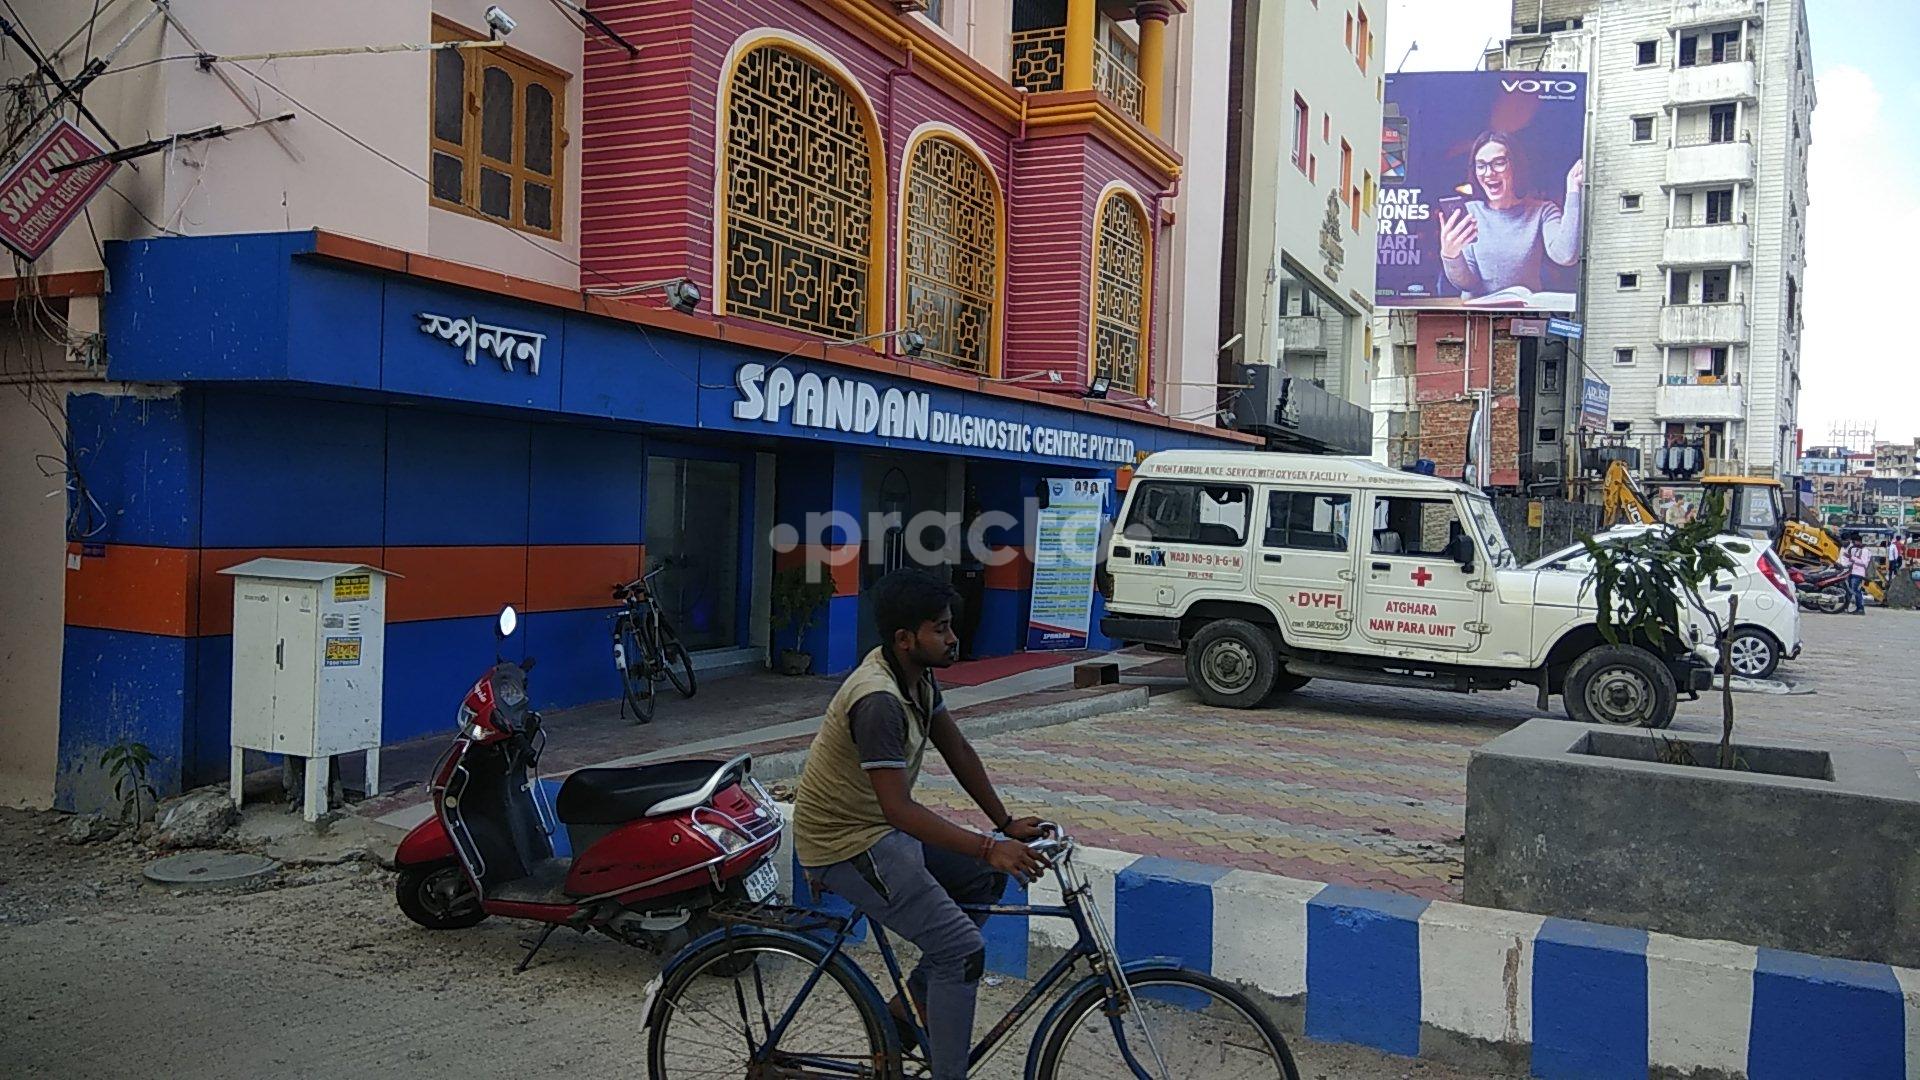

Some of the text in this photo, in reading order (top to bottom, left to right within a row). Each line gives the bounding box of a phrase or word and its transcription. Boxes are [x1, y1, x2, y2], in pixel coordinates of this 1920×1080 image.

[1501, 79, 1577, 93] VOTO
[0, 137, 79, 225] SHALINI
[1394, 219, 1409, 235] A
[415, 312, 548, 376] স্পন্দন
[733, 362, 930, 442] SPANDAN
[930, 410, 1032, 454] DIAGNOSTIC
[1033, 426, 1088, 459] CENTRE
[1275, 469, 1308, 480] OXYGEN
[1309, 470, 1349, 482] FACILITY
[1793, 531, 1818, 545] JCB
[1134, 550, 1167, 568] MaXX
[1169, 551, 1190, 563] WARD
[1297, 591, 1343, 610] DYFI
[1385, 600, 1438, 617] ATGHARA
[1369, 618, 1457, 638] NAW PARA UNIT
